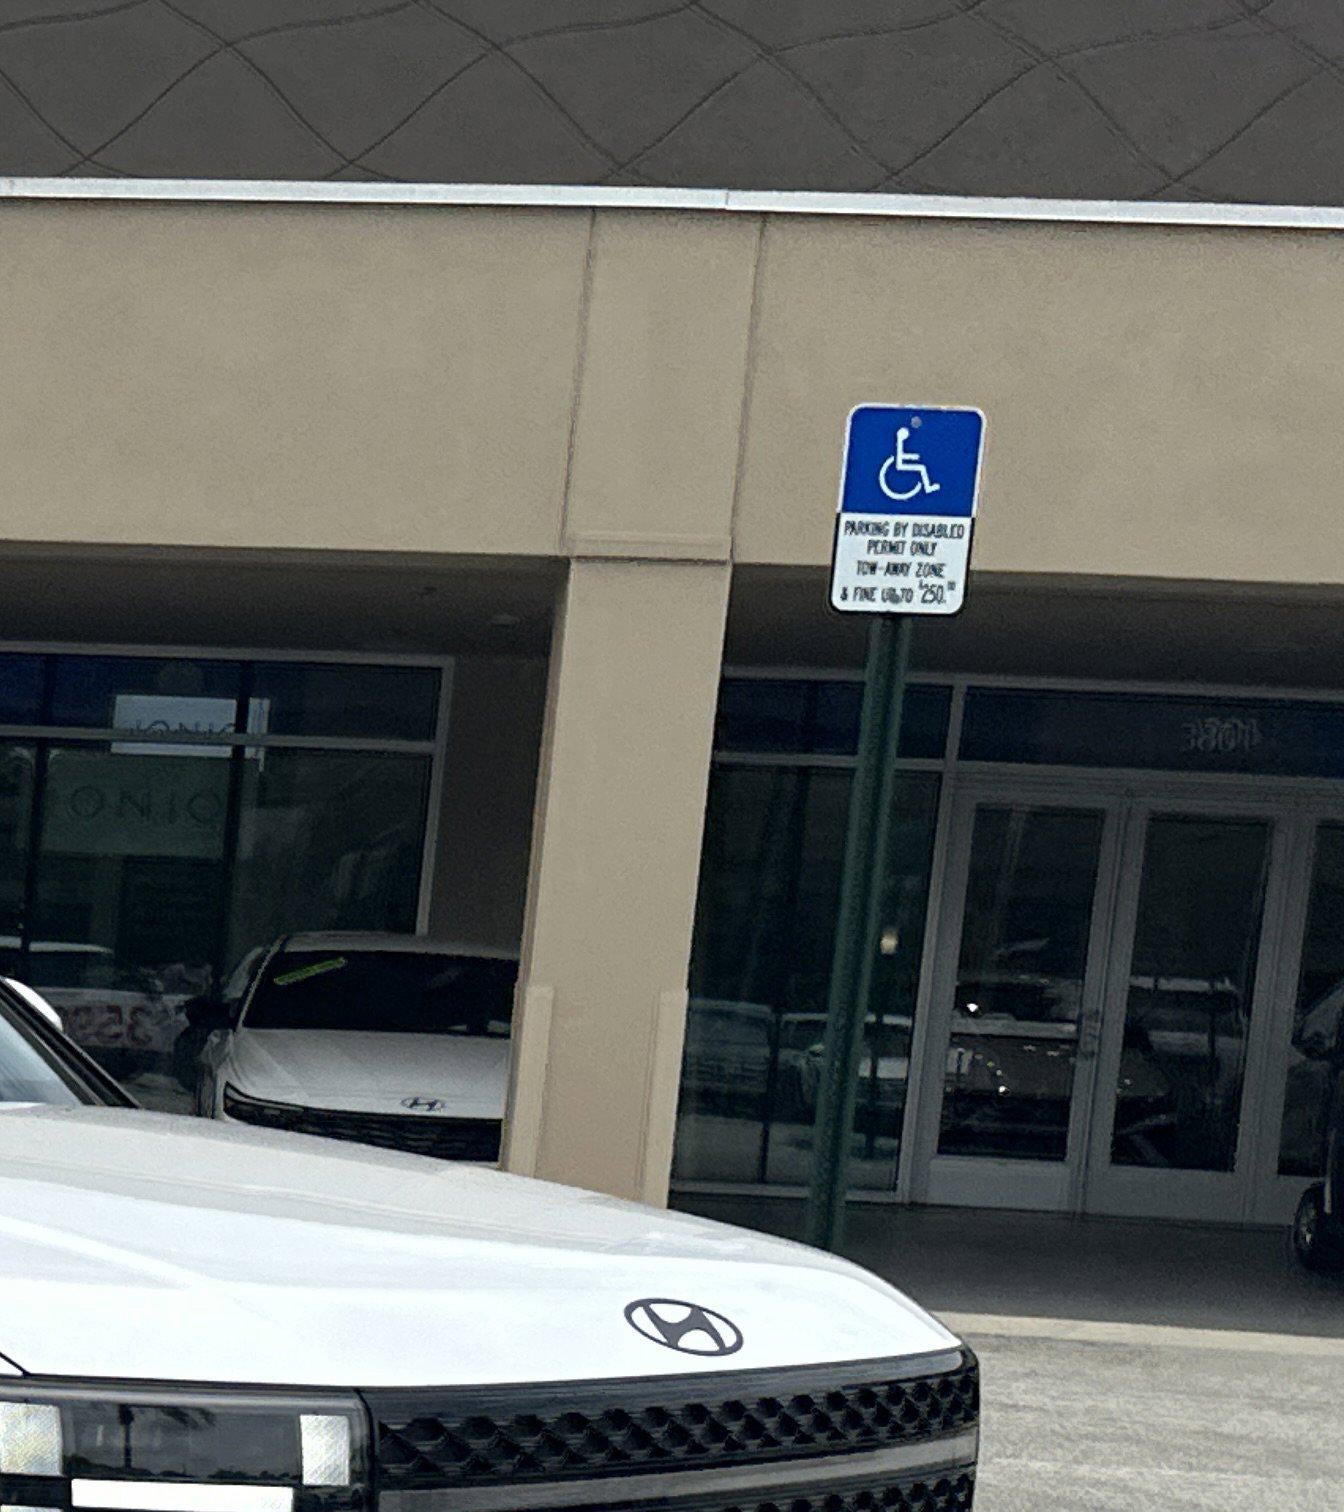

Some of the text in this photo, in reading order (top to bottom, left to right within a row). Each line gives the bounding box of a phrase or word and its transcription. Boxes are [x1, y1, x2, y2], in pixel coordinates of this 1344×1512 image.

[843, 520, 965, 539] PARKING BY DISABLED
[866, 539, 937, 557] PERMIT ONLY
[856, 560, 946, 578] TOW-AWAY ZONE
[840, 586, 849, 601] &
[852, 586, 878, 603] FINE
